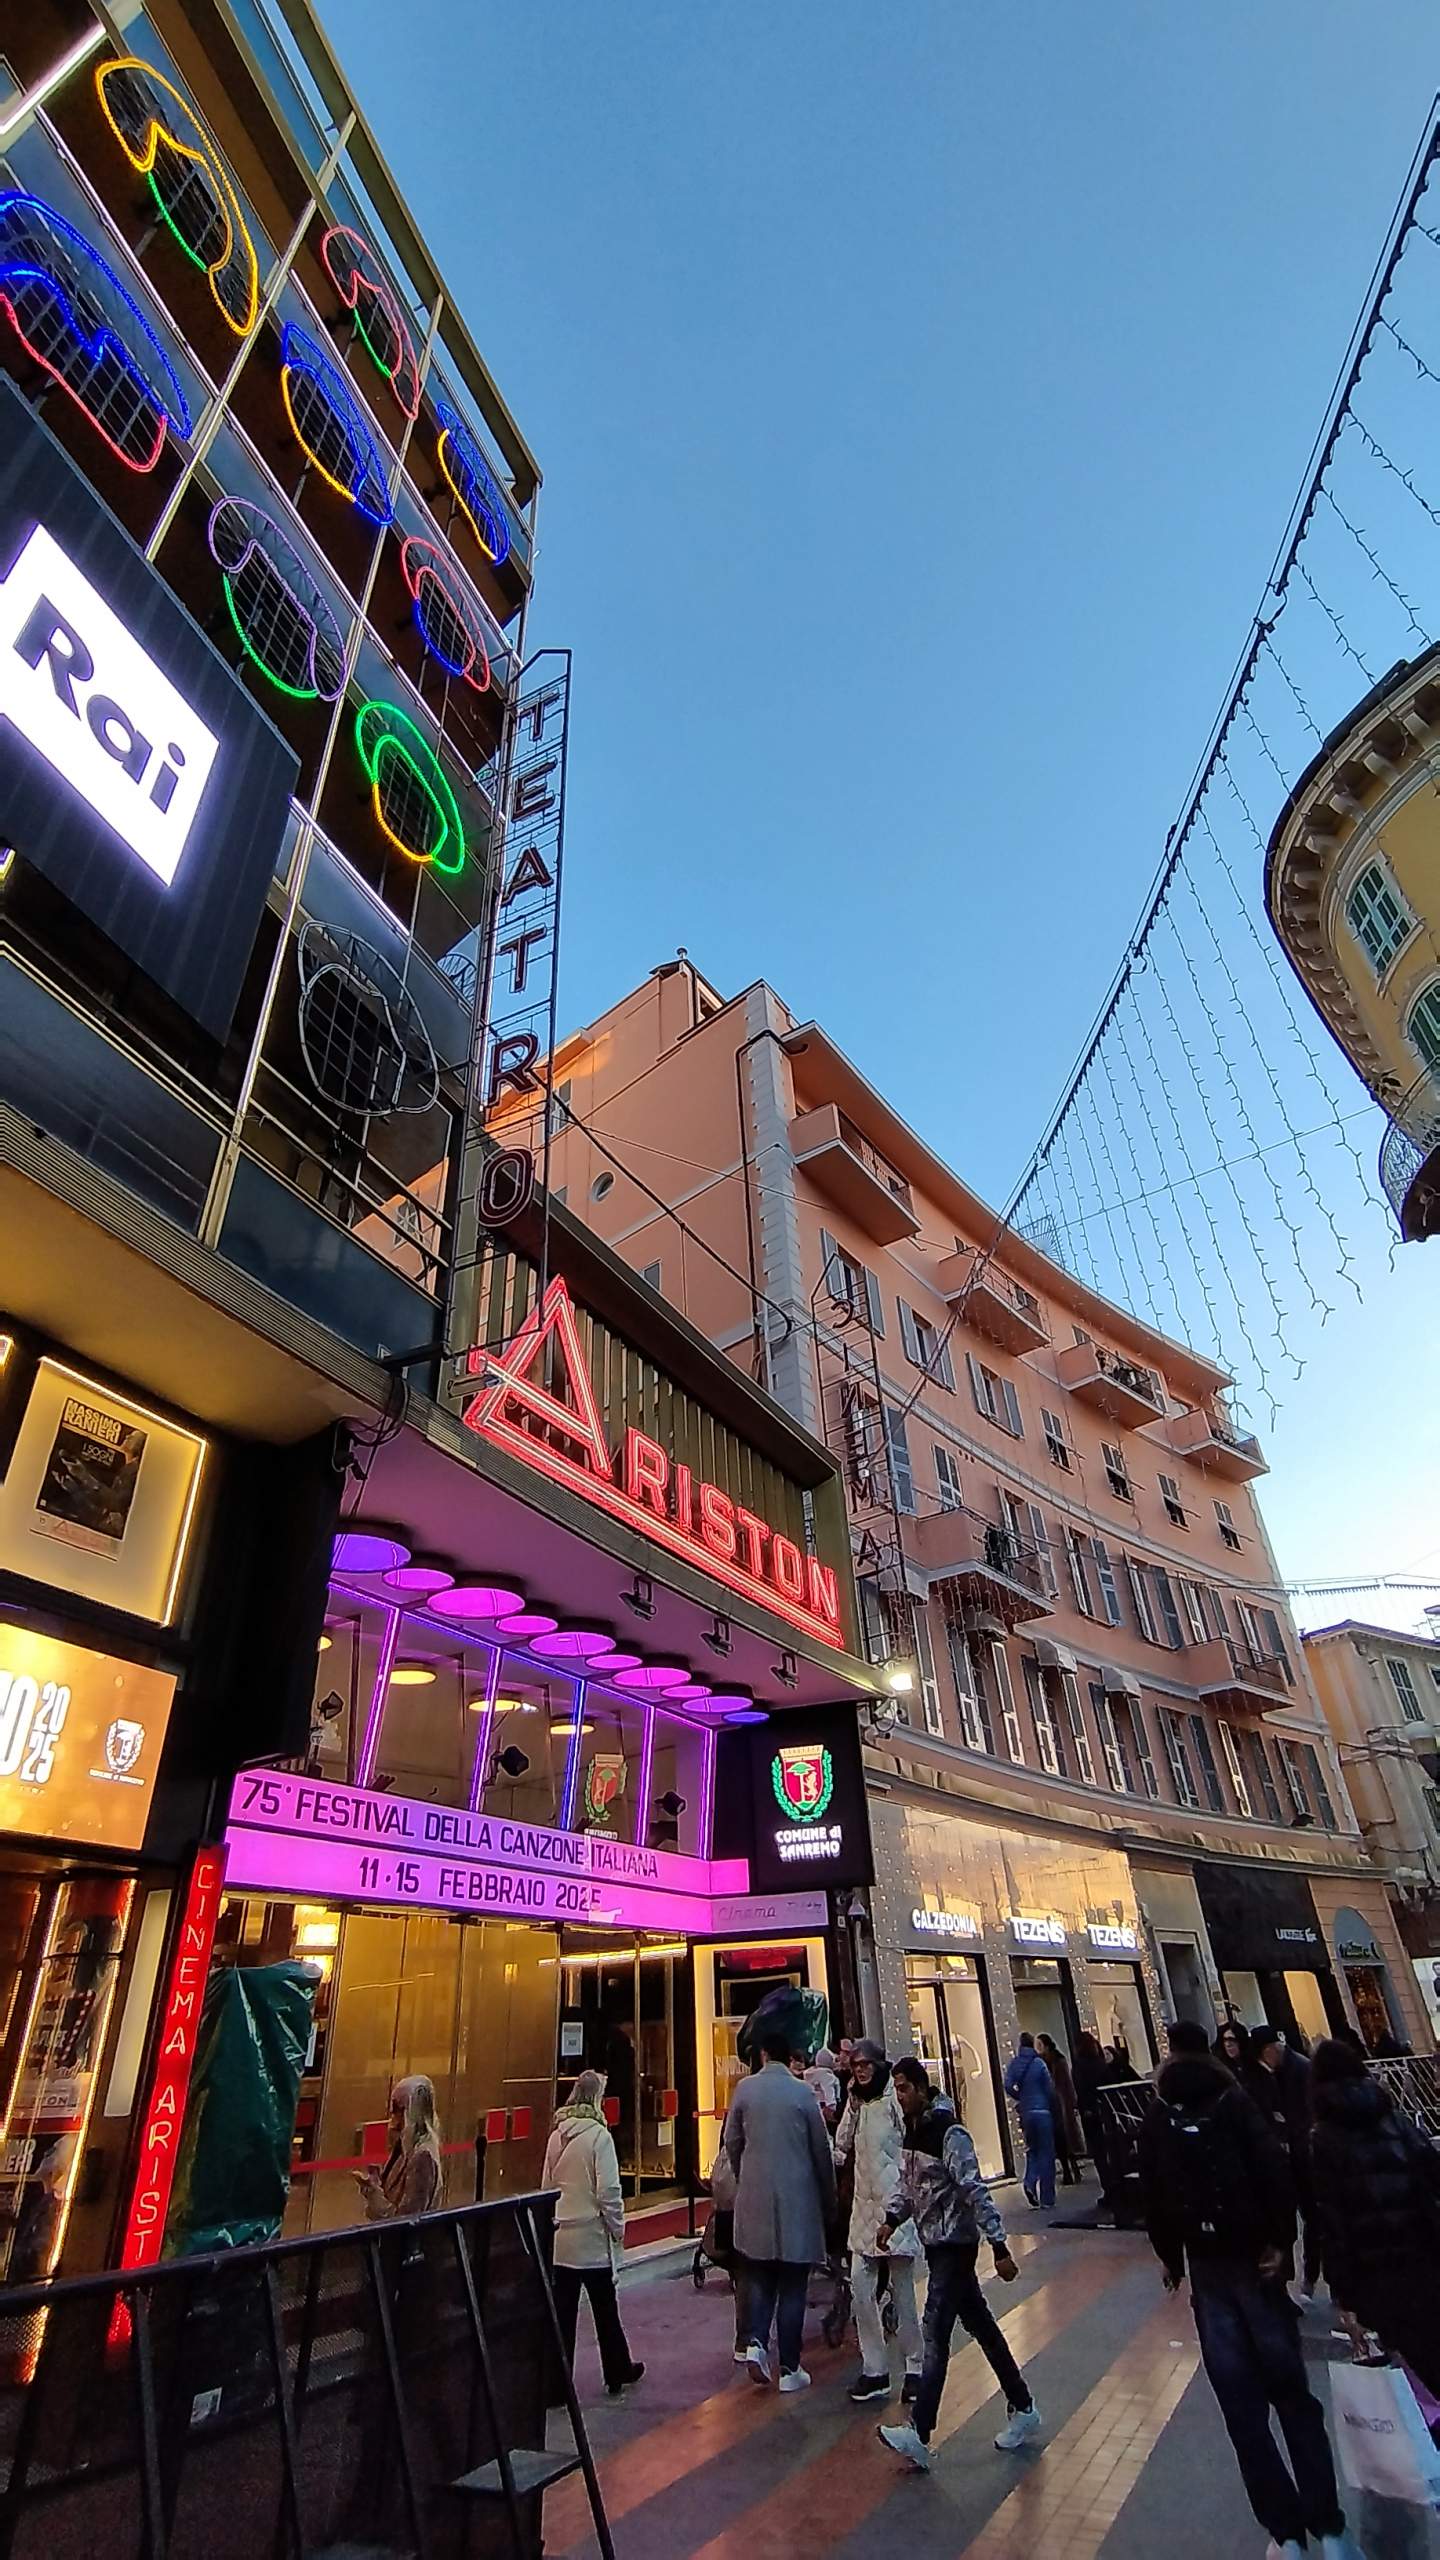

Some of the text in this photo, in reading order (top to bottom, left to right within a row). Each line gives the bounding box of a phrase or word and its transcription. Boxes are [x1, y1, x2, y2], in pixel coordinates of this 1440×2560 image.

[13, 593, 185, 814] Rai
[476, 687, 561, 1226] TEATRO
[64, 1411, 120, 1443] RANIERI
[66, 1400, 121, 1432] MASSIMO
[464, 1274, 841, 1630] ARISTON
[295, 1788, 414, 1837] FESTIVAL
[424, 1811, 492, 1850] DELLA
[500, 1826, 584, 1866] CANZONE
[592, 1844, 658, 1879] ITALIANA
[775, 1826, 827, 1843] COMUNE
[779, 1841, 840, 1860] SANREMO
[439, 1867, 546, 1907] FEBBRAIO
[912, 1908, 977, 1934] CALZEDONIA
[165, 1864, 214, 2055] CINEMA
